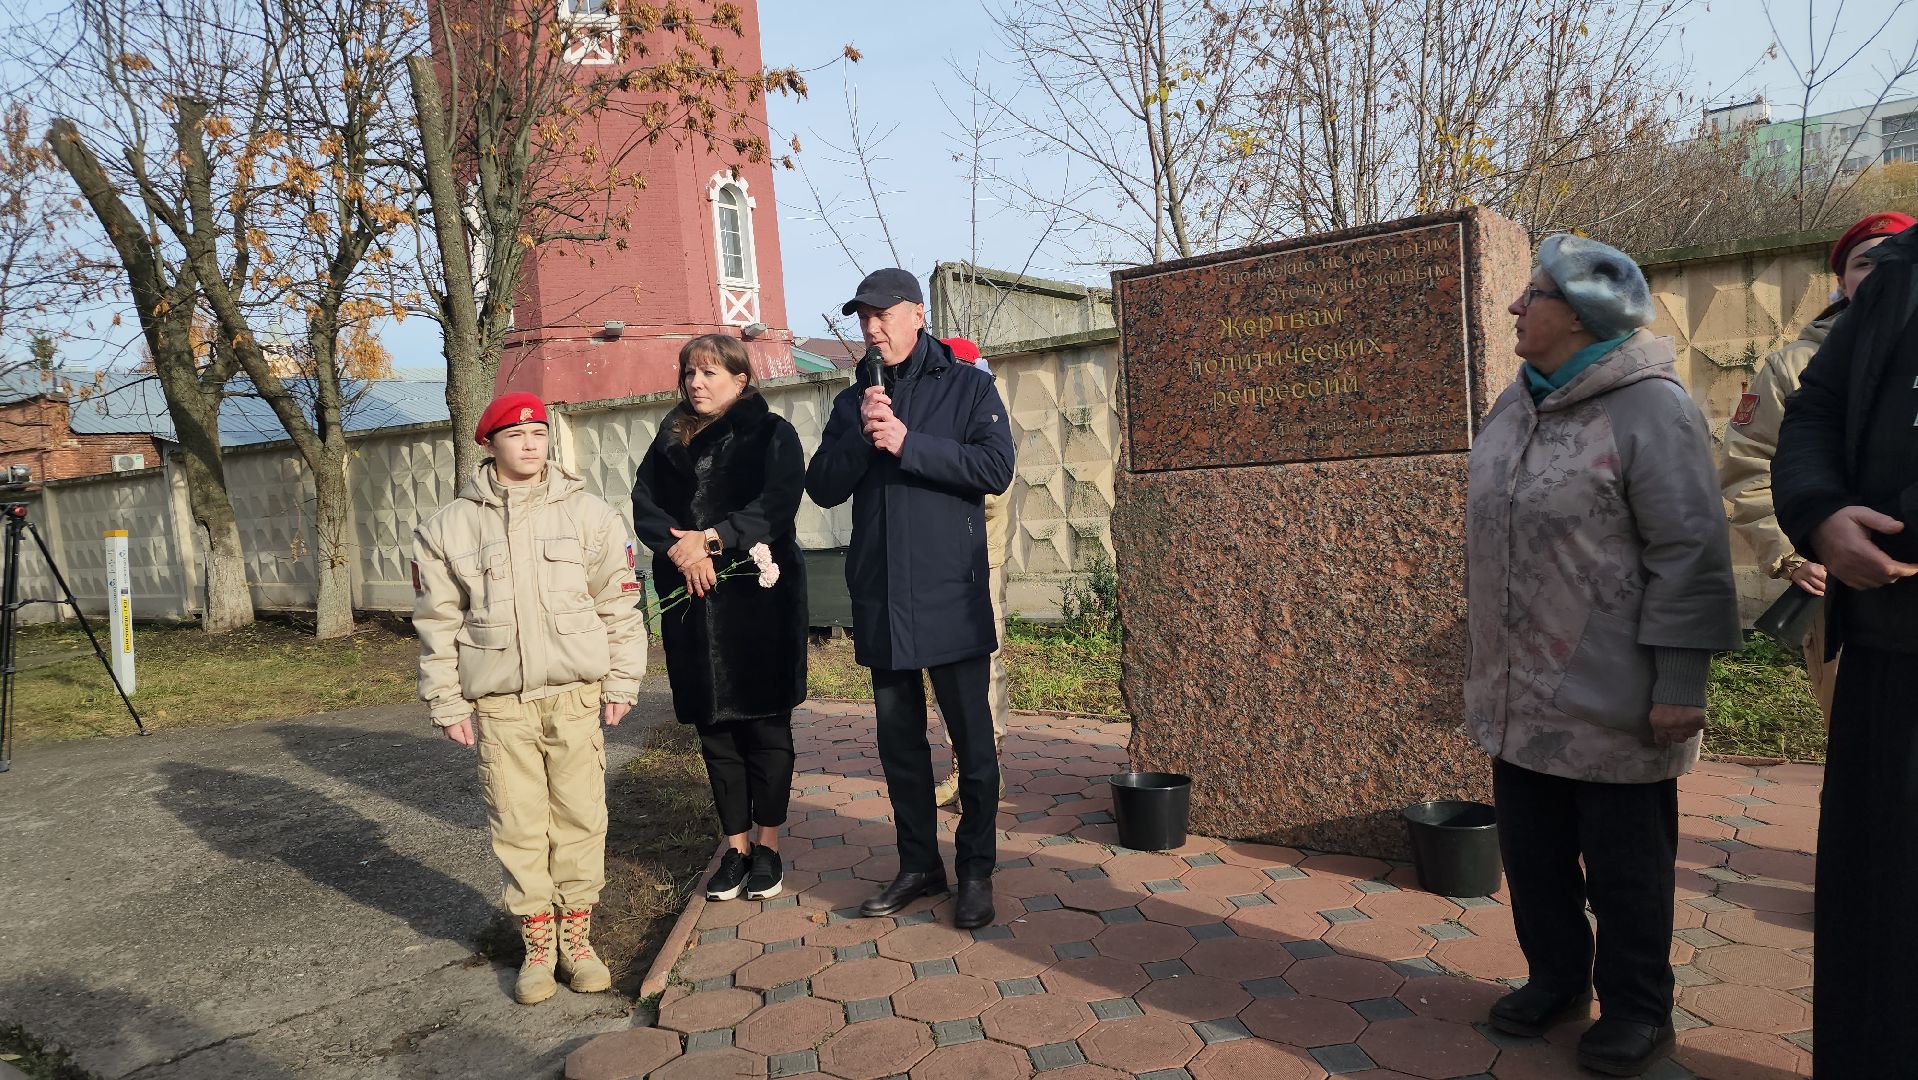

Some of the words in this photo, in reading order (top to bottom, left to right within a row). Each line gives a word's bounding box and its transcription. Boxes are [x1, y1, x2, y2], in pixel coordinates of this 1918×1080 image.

[1321, 256, 1345, 270] не
[1267, 286, 1300, 302] Это
[1306, 276, 1368, 299] нужно
[1369, 263, 1450, 286] живым
[1217, 306, 1343, 339] Жертвам
[1190, 338, 1383, 376] политических
[1213, 368, 1360, 412] репрессий
